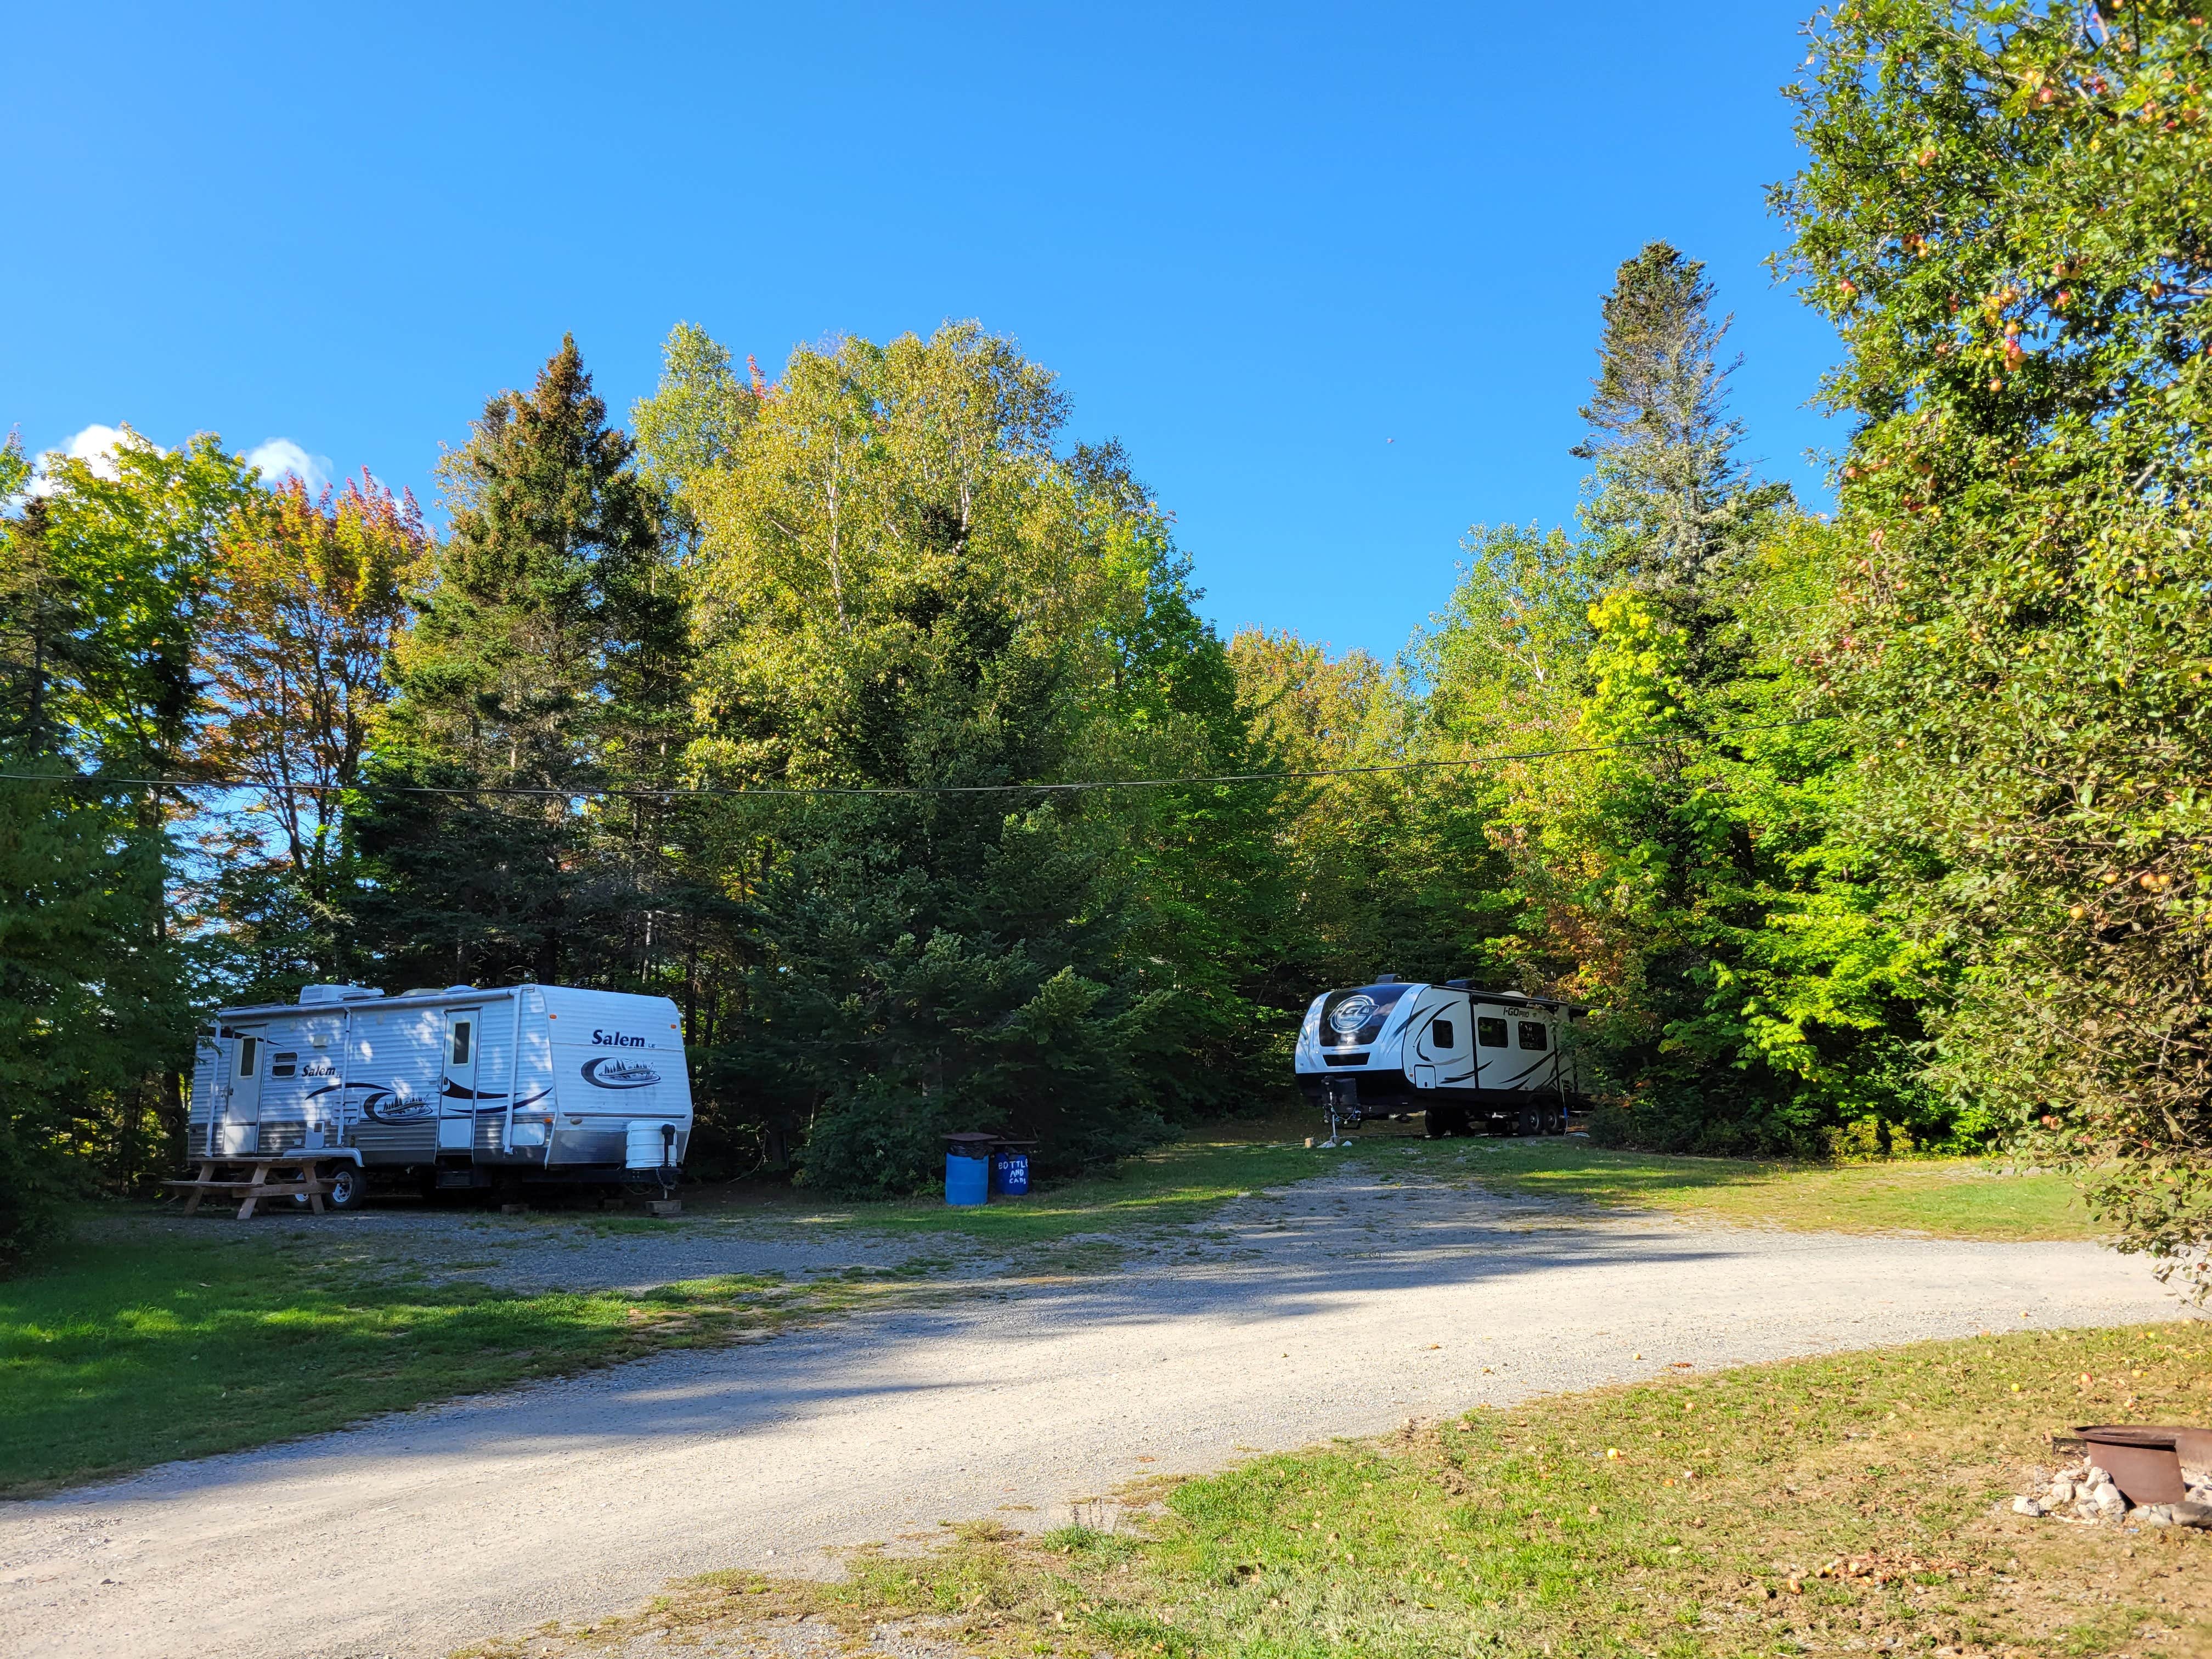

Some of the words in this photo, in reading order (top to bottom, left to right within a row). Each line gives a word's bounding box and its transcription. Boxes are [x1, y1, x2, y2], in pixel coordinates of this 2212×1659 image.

[592, 1029, 645, 1047] Salem
[302, 1065, 336, 1077] Salem
[1010, 1169, 1024, 1178] AND
